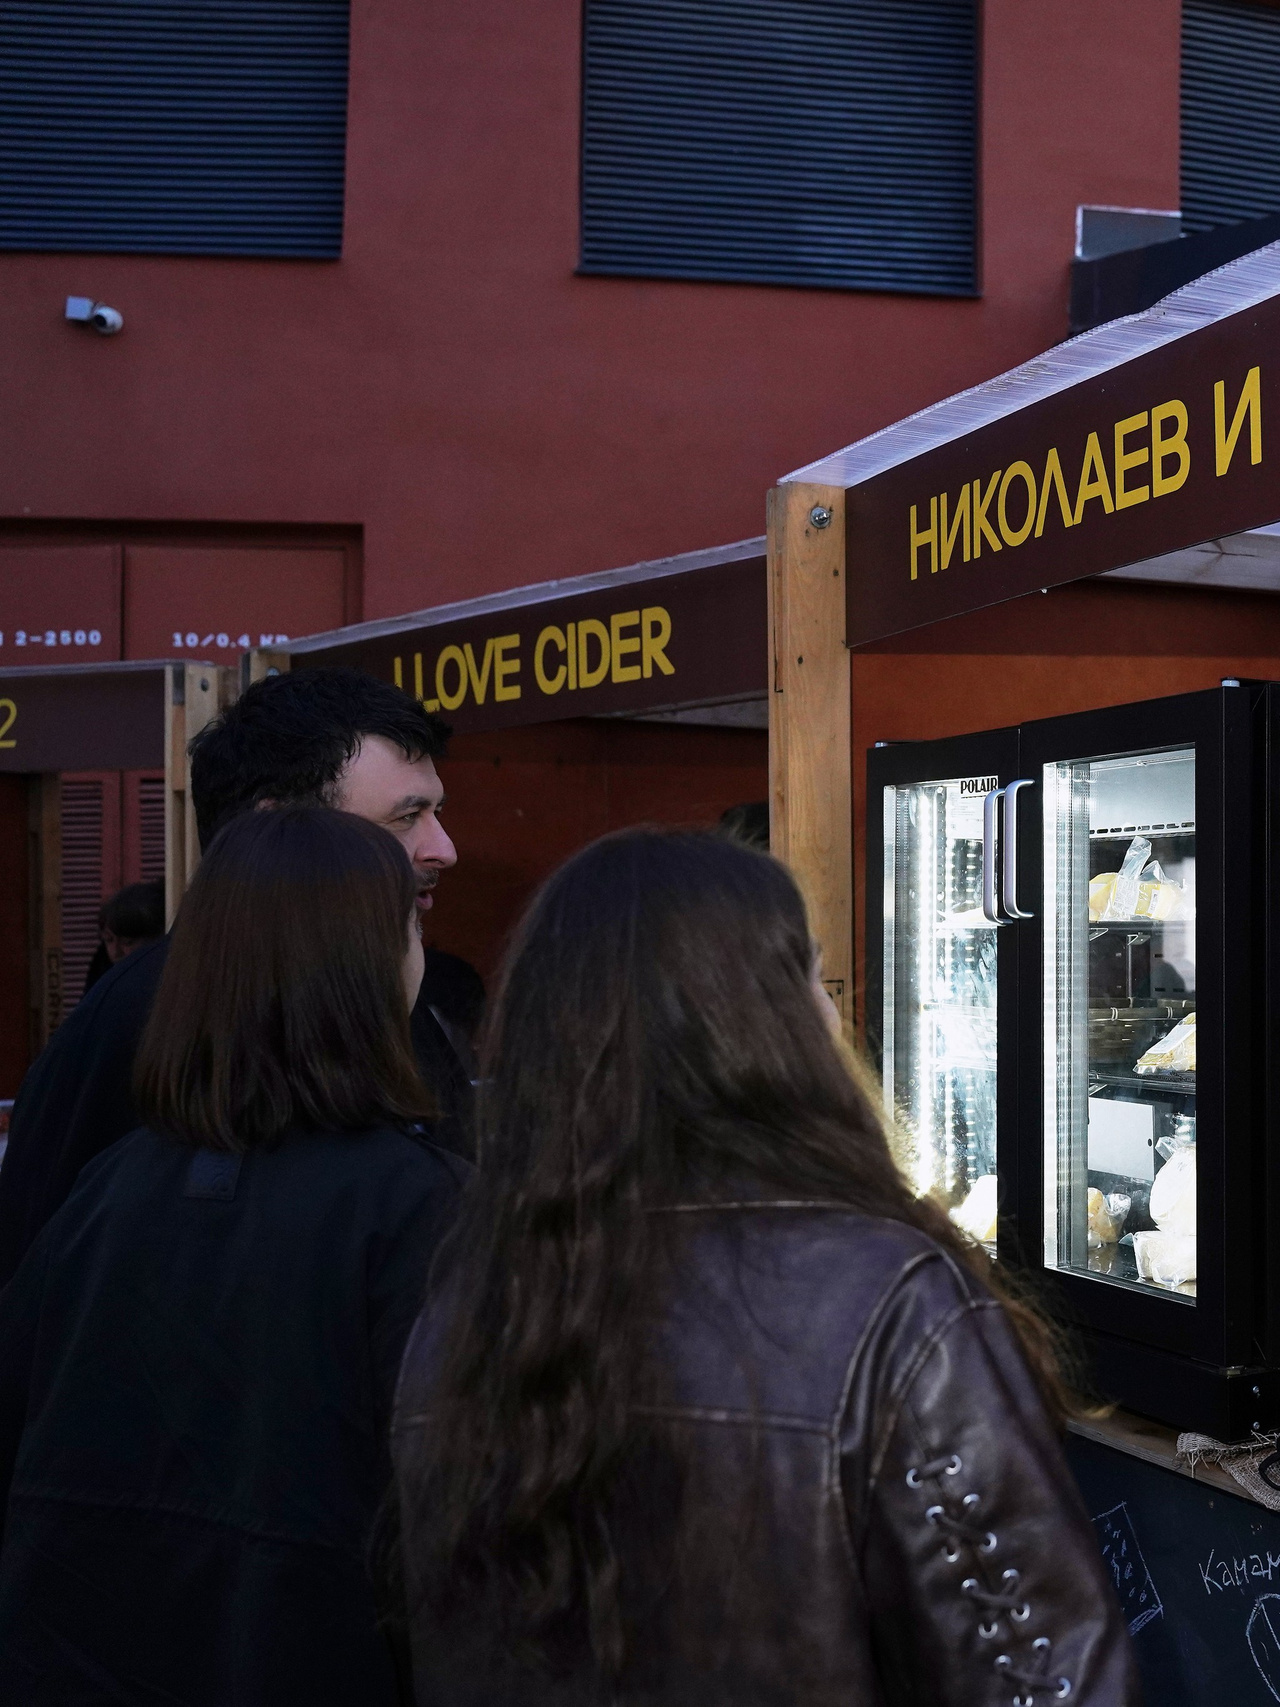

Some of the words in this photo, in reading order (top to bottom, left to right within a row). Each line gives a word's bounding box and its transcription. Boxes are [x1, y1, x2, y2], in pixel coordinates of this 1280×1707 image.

[910, 400, 1190, 581] НИКОЛАЕВ
[1215, 368, 1262, 476] И
[414, 633, 521, 713] LOVE
[534, 606, 675, 695] CIDER
[960, 777, 998, 794] POLAIR
